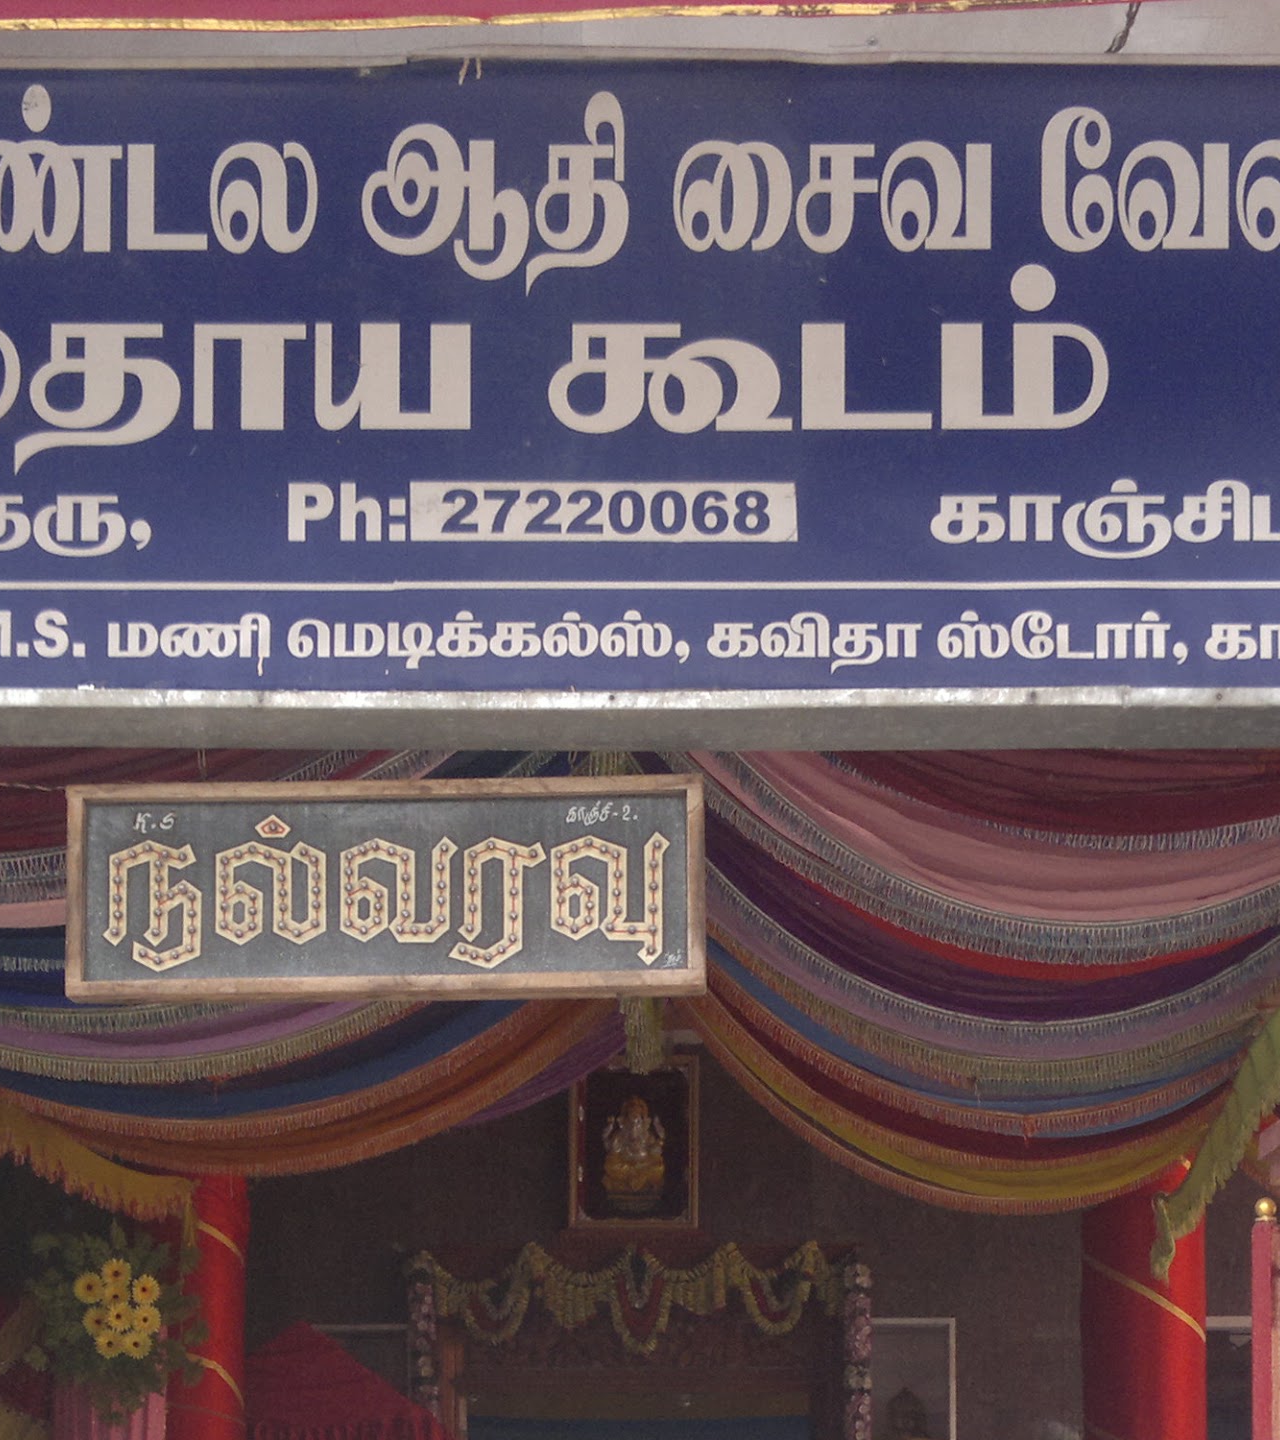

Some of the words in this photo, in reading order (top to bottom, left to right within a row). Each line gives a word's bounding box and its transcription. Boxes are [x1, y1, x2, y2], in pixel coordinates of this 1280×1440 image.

[362, 91, 629, 293] ஆதி
[673, 140, 991, 253] சைவ
[547, 263, 1110, 434] கூடம்
[288, 482, 407, 542] Ph:
[441, 489, 773, 535] 27220068
[107, 612, 271, 664] மணி
[287, 609, 691, 670] மெடிக்கல்ஸ்,
[707, 611, 922, 674] கவிதா
[937, 610, 1190, 665] ஸ்டோர்,
[102, 813, 671, 972] நல்வரவு
